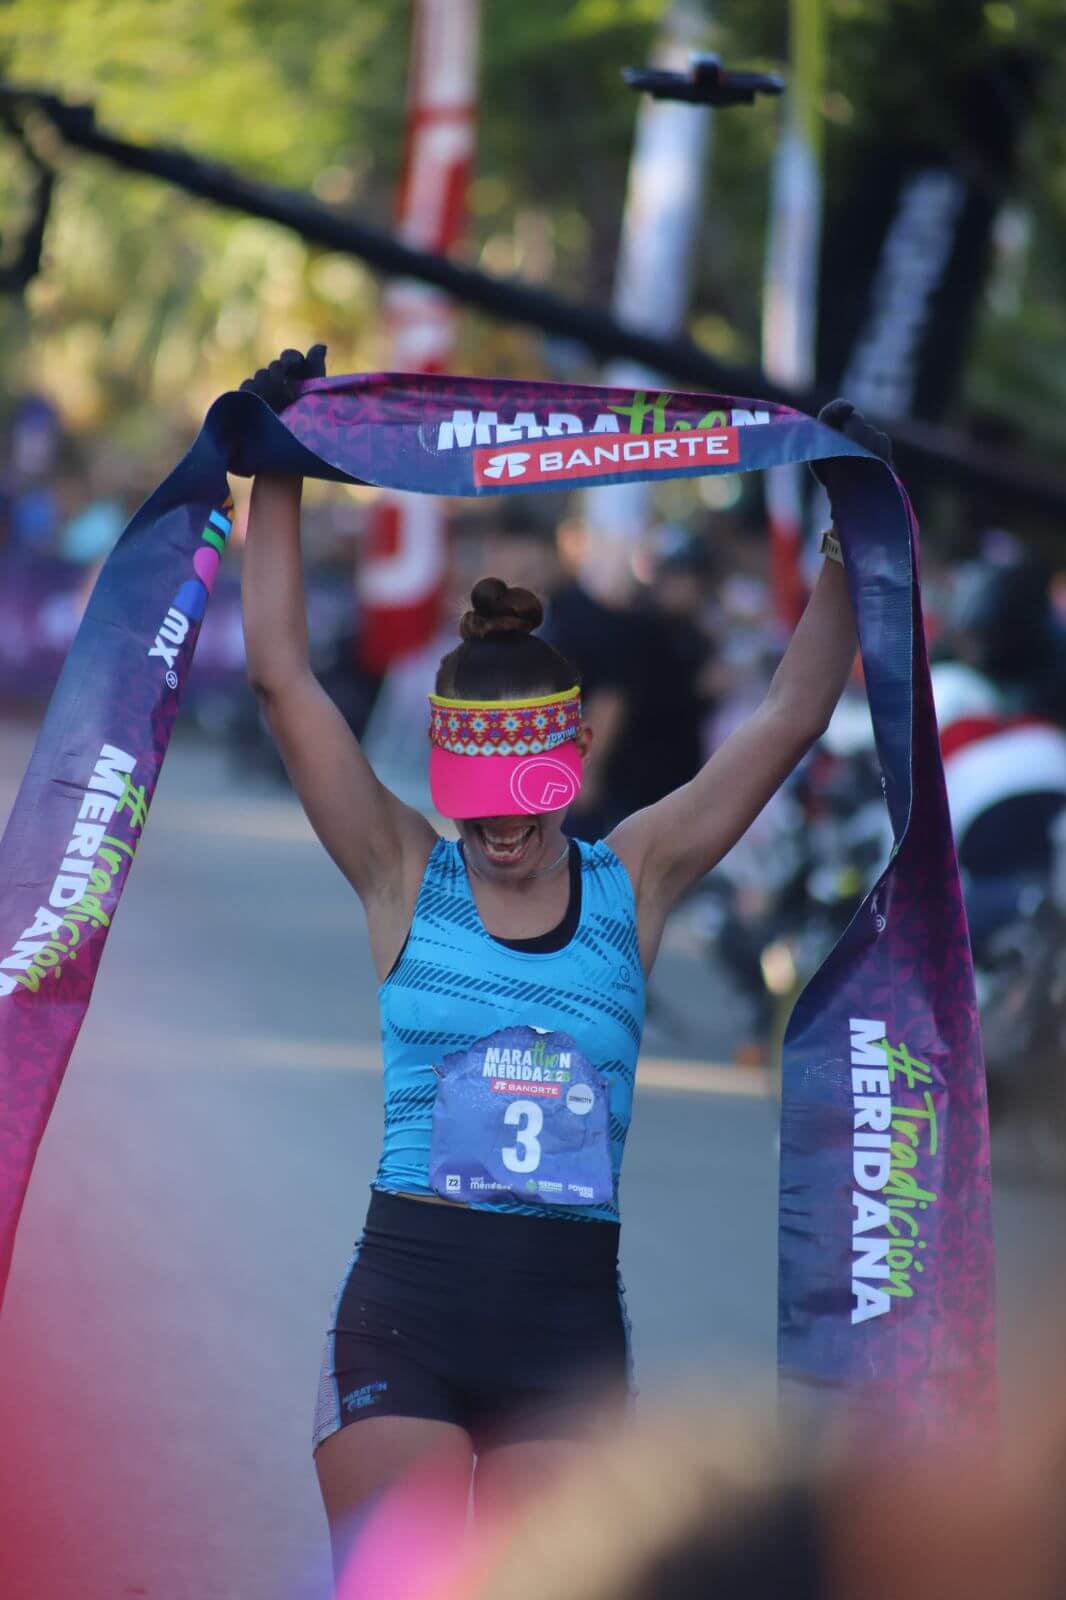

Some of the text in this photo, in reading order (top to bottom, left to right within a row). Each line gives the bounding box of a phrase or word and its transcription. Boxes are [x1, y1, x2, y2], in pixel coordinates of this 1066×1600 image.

[539, 435, 730, 473] BANORTE
[508, 1083, 559, 1096] BANORTE
[501, 1099, 544, 1174] 3
[848, 1017, 892, 1325] MERIDANA
